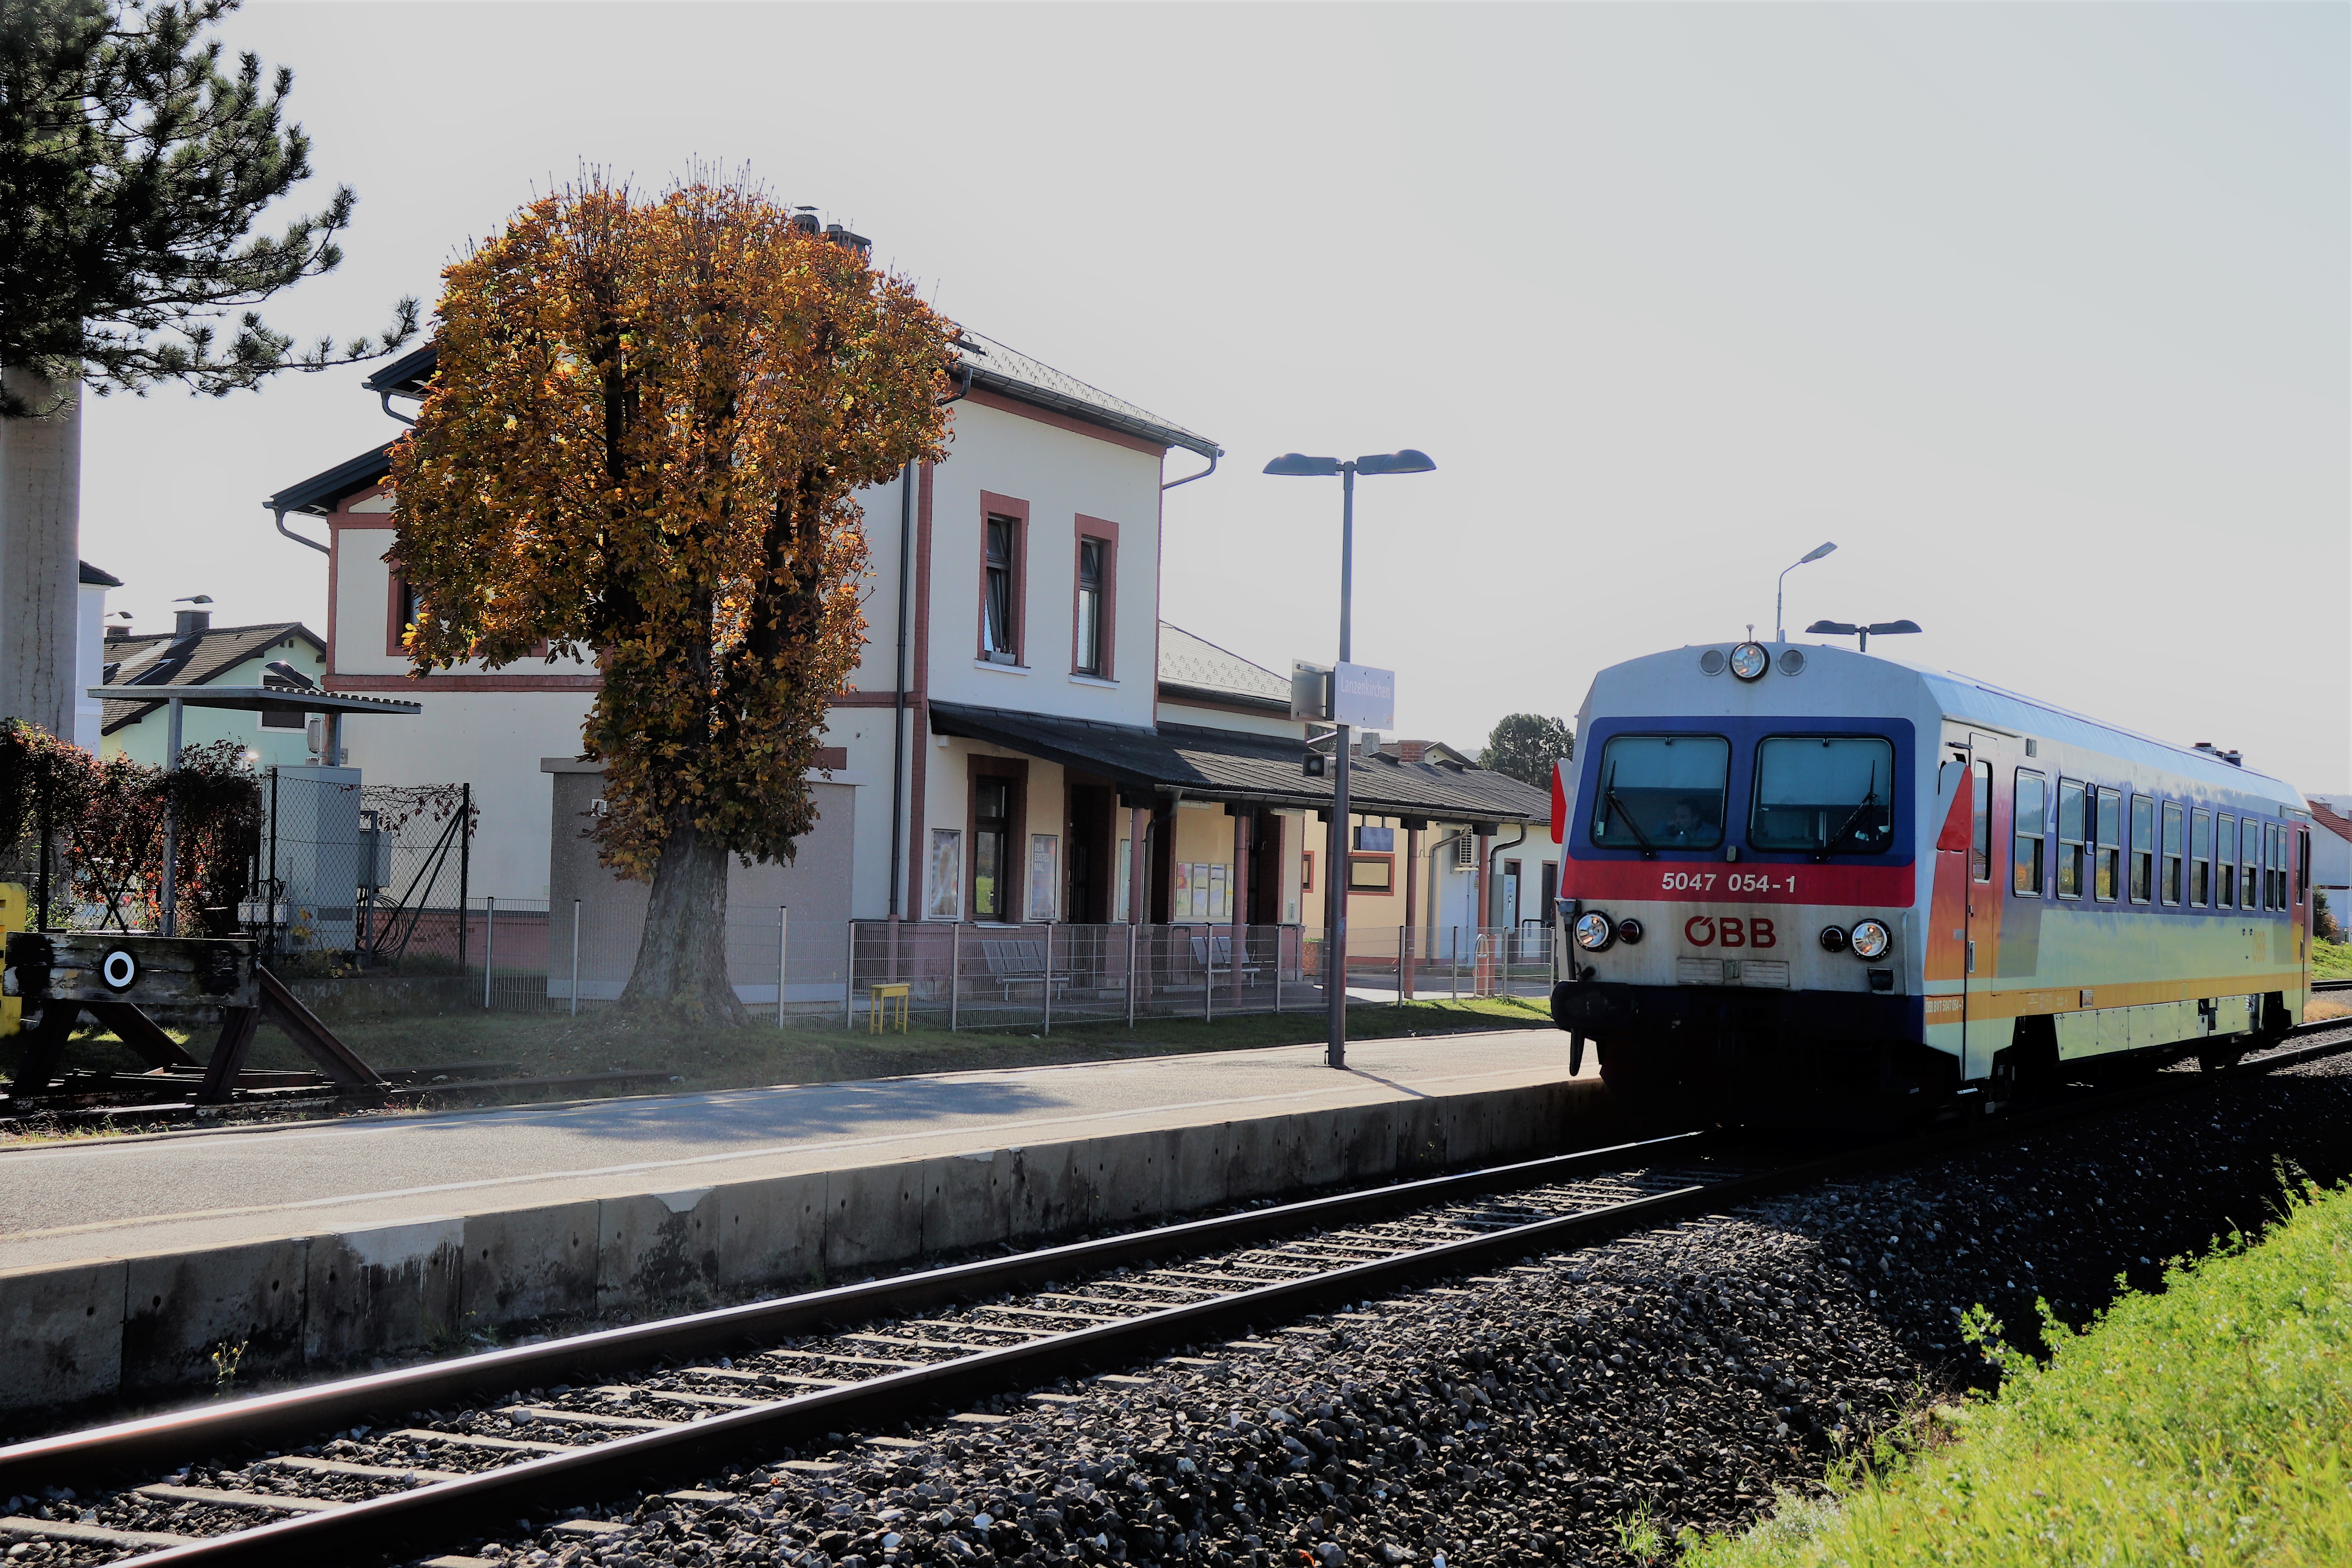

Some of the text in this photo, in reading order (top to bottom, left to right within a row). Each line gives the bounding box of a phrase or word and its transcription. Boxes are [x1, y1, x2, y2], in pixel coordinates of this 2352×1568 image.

[1341, 675, 1390, 699] Lanzenkirchen
[2047, 773, 2055, 833] 2
[1034, 853, 1049, 862] ERSTES
[1662, 873, 1717, 891] 5047
[1685, 916, 1776, 948] ÖBB
